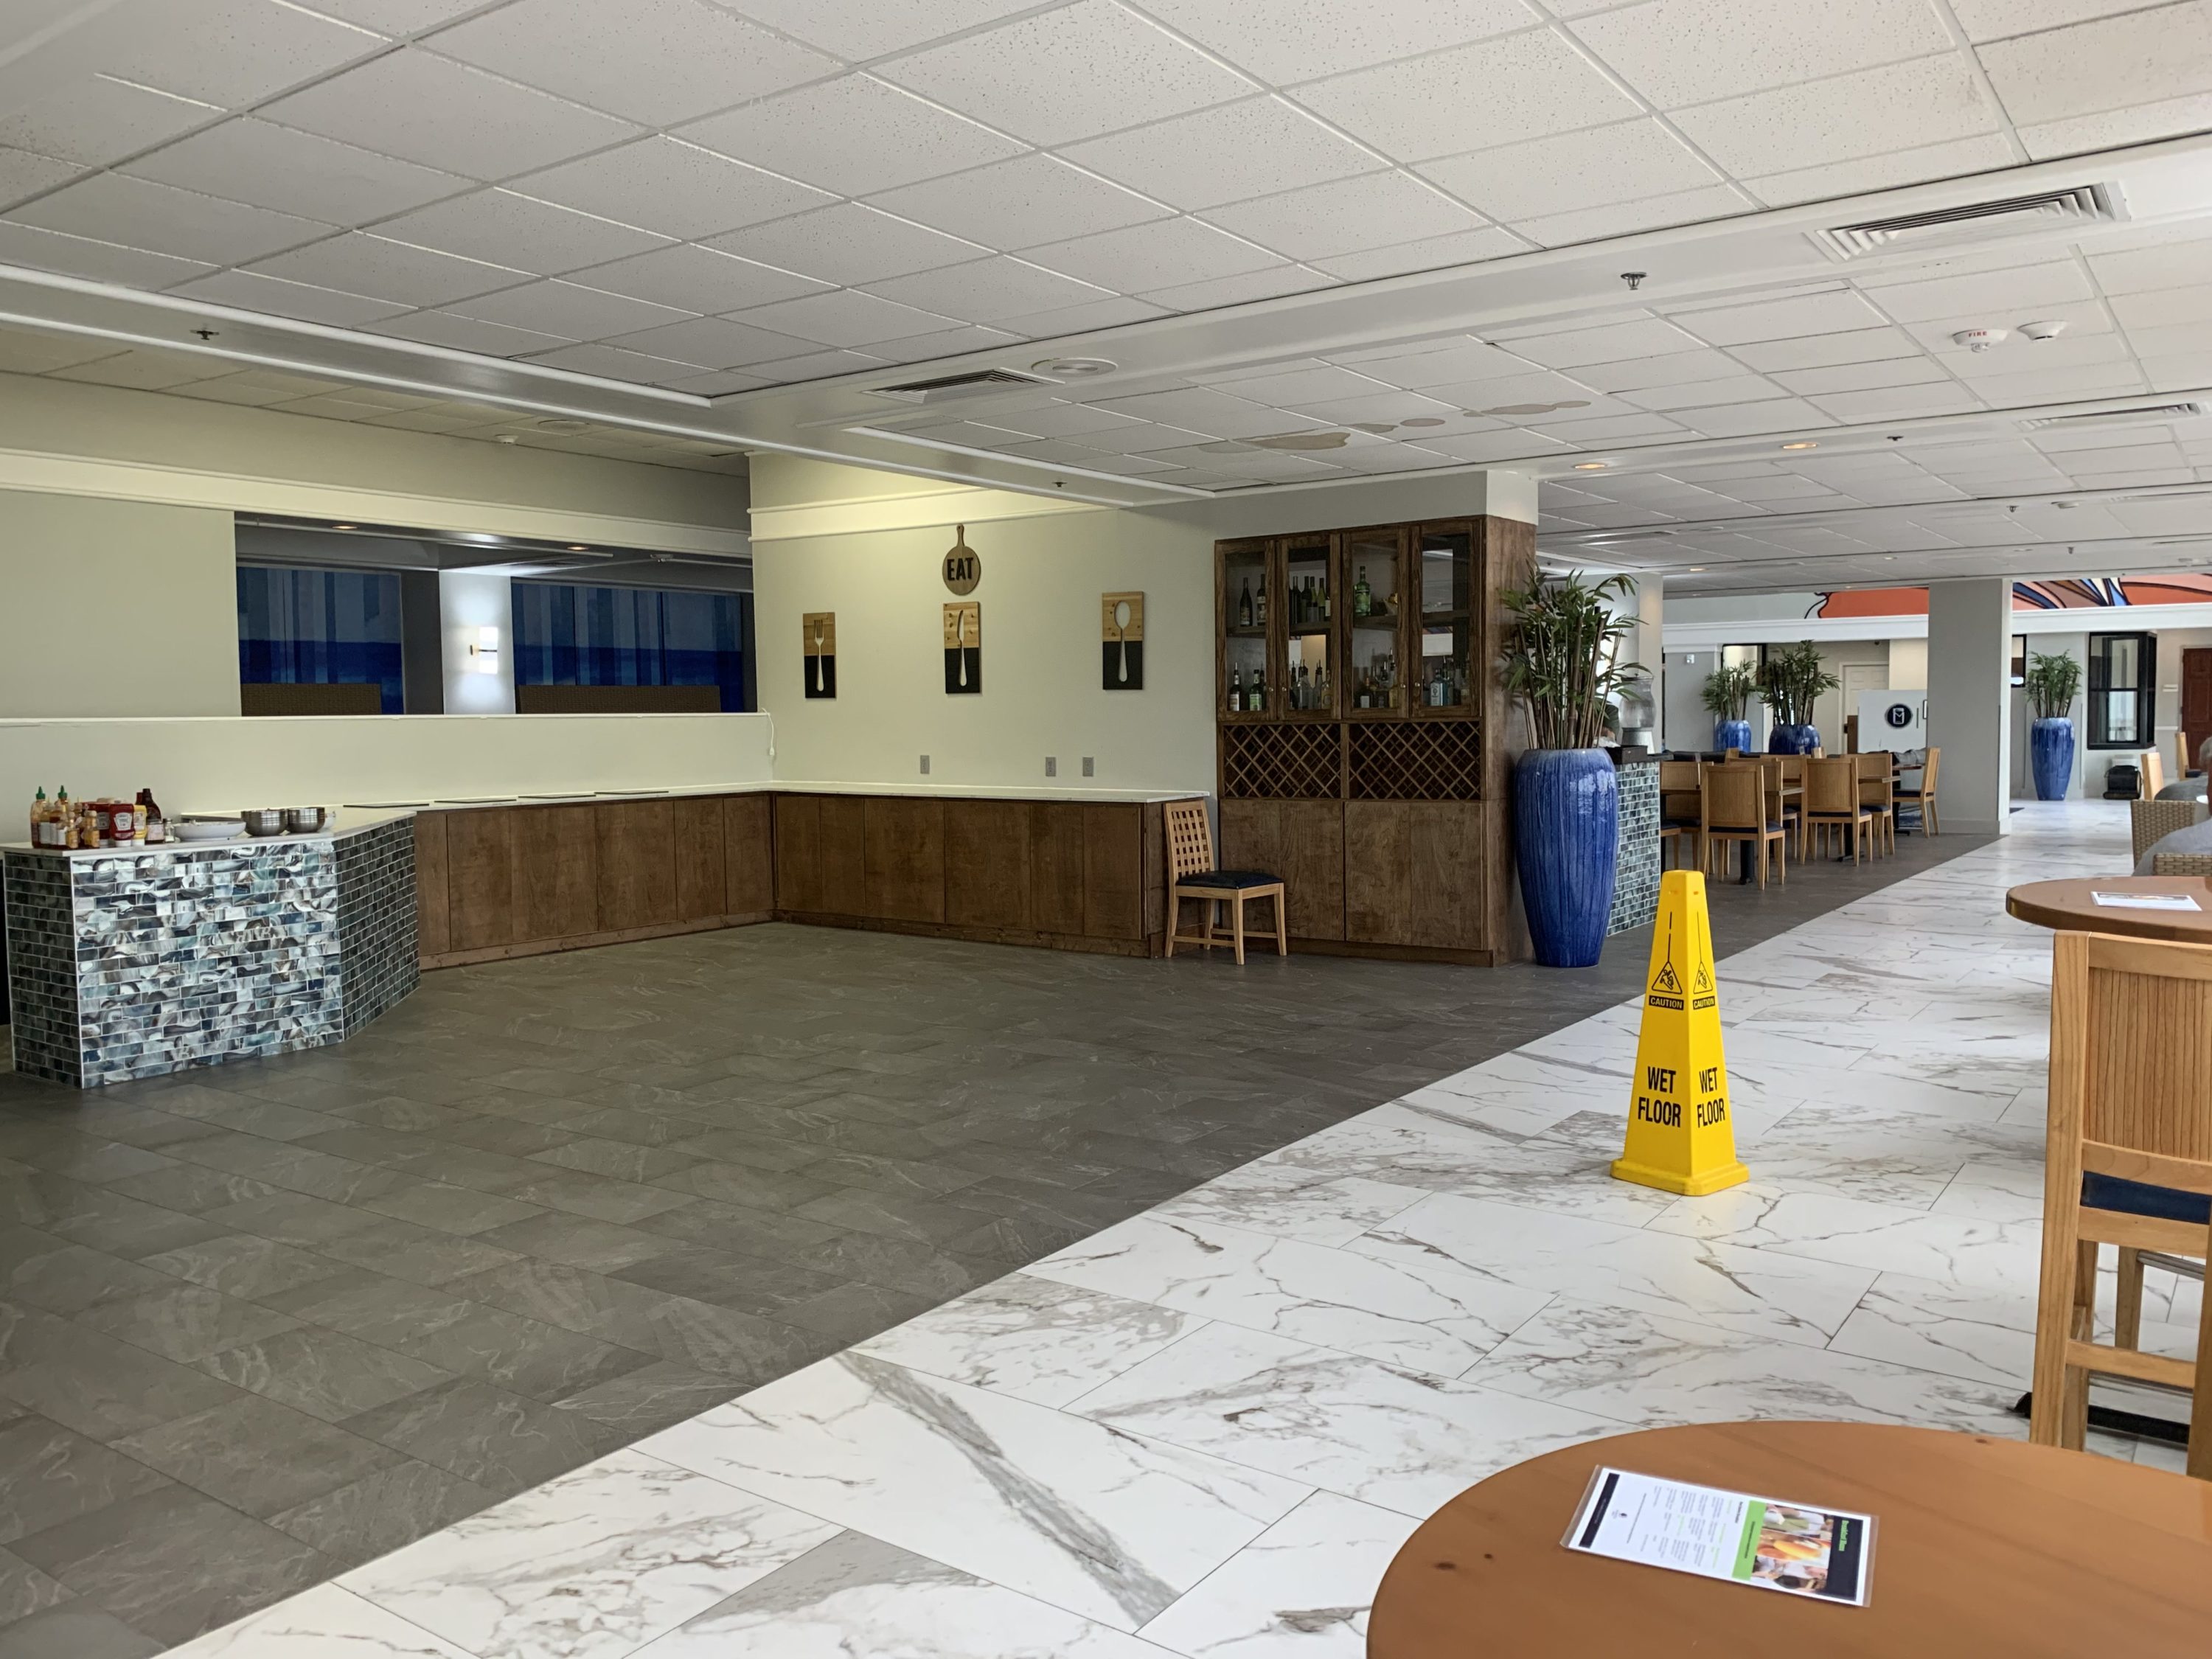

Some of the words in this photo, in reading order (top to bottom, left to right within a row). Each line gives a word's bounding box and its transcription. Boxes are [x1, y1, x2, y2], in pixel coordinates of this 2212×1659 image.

[947, 557, 973, 580] EAT
[1650, 997, 1683, 1009] CAUTION
[1694, 998, 1714, 1009] CAUTION
[1647, 1066, 1677, 1094] WET
[1699, 1067, 1718, 1094] WET
[1638, 1096, 1681, 1128] FLOOR
[1697, 1098, 1725, 1128] FLOOR
